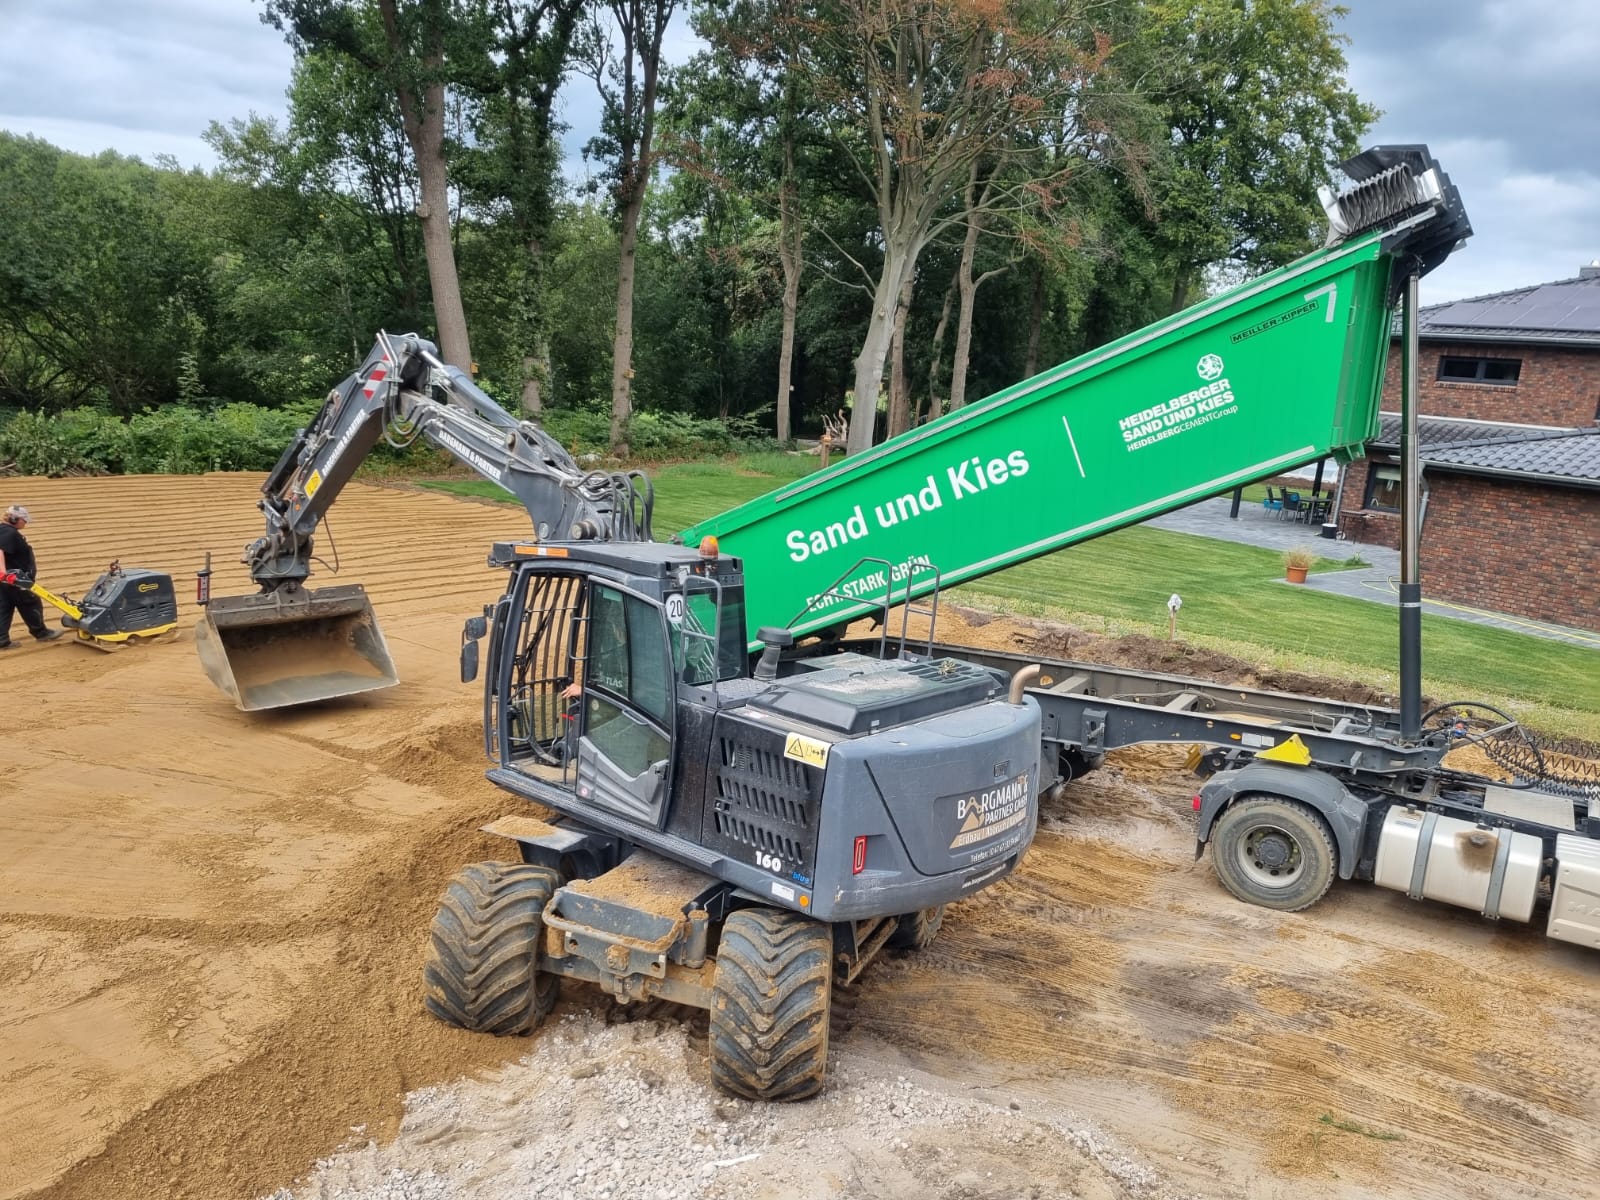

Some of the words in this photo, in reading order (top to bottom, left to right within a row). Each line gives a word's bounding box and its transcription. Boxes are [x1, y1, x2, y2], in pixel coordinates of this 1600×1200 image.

[1232, 302, 1316, 342] MEILLER-KIPPER
[1119, 378, 1231, 430] HEIDELBERGER
[1122, 419, 1163, 442] SAND
[1163, 405, 1196, 426] UND
[1196, 391, 1235, 414] KIES
[439, 430, 470, 458] BARGMANN
[469, 451, 475, 462] &
[474, 455, 501, 480] PARTNER
[786, 505, 869, 562] Sand
[874, 475, 943, 528] und
[946, 450, 1030, 500] Kies
[669, 600, 682, 618] 20
[984, 803, 1014, 825] PARTNER
[755, 850, 782, 872] 160
[791, 871, 810, 884] blue
